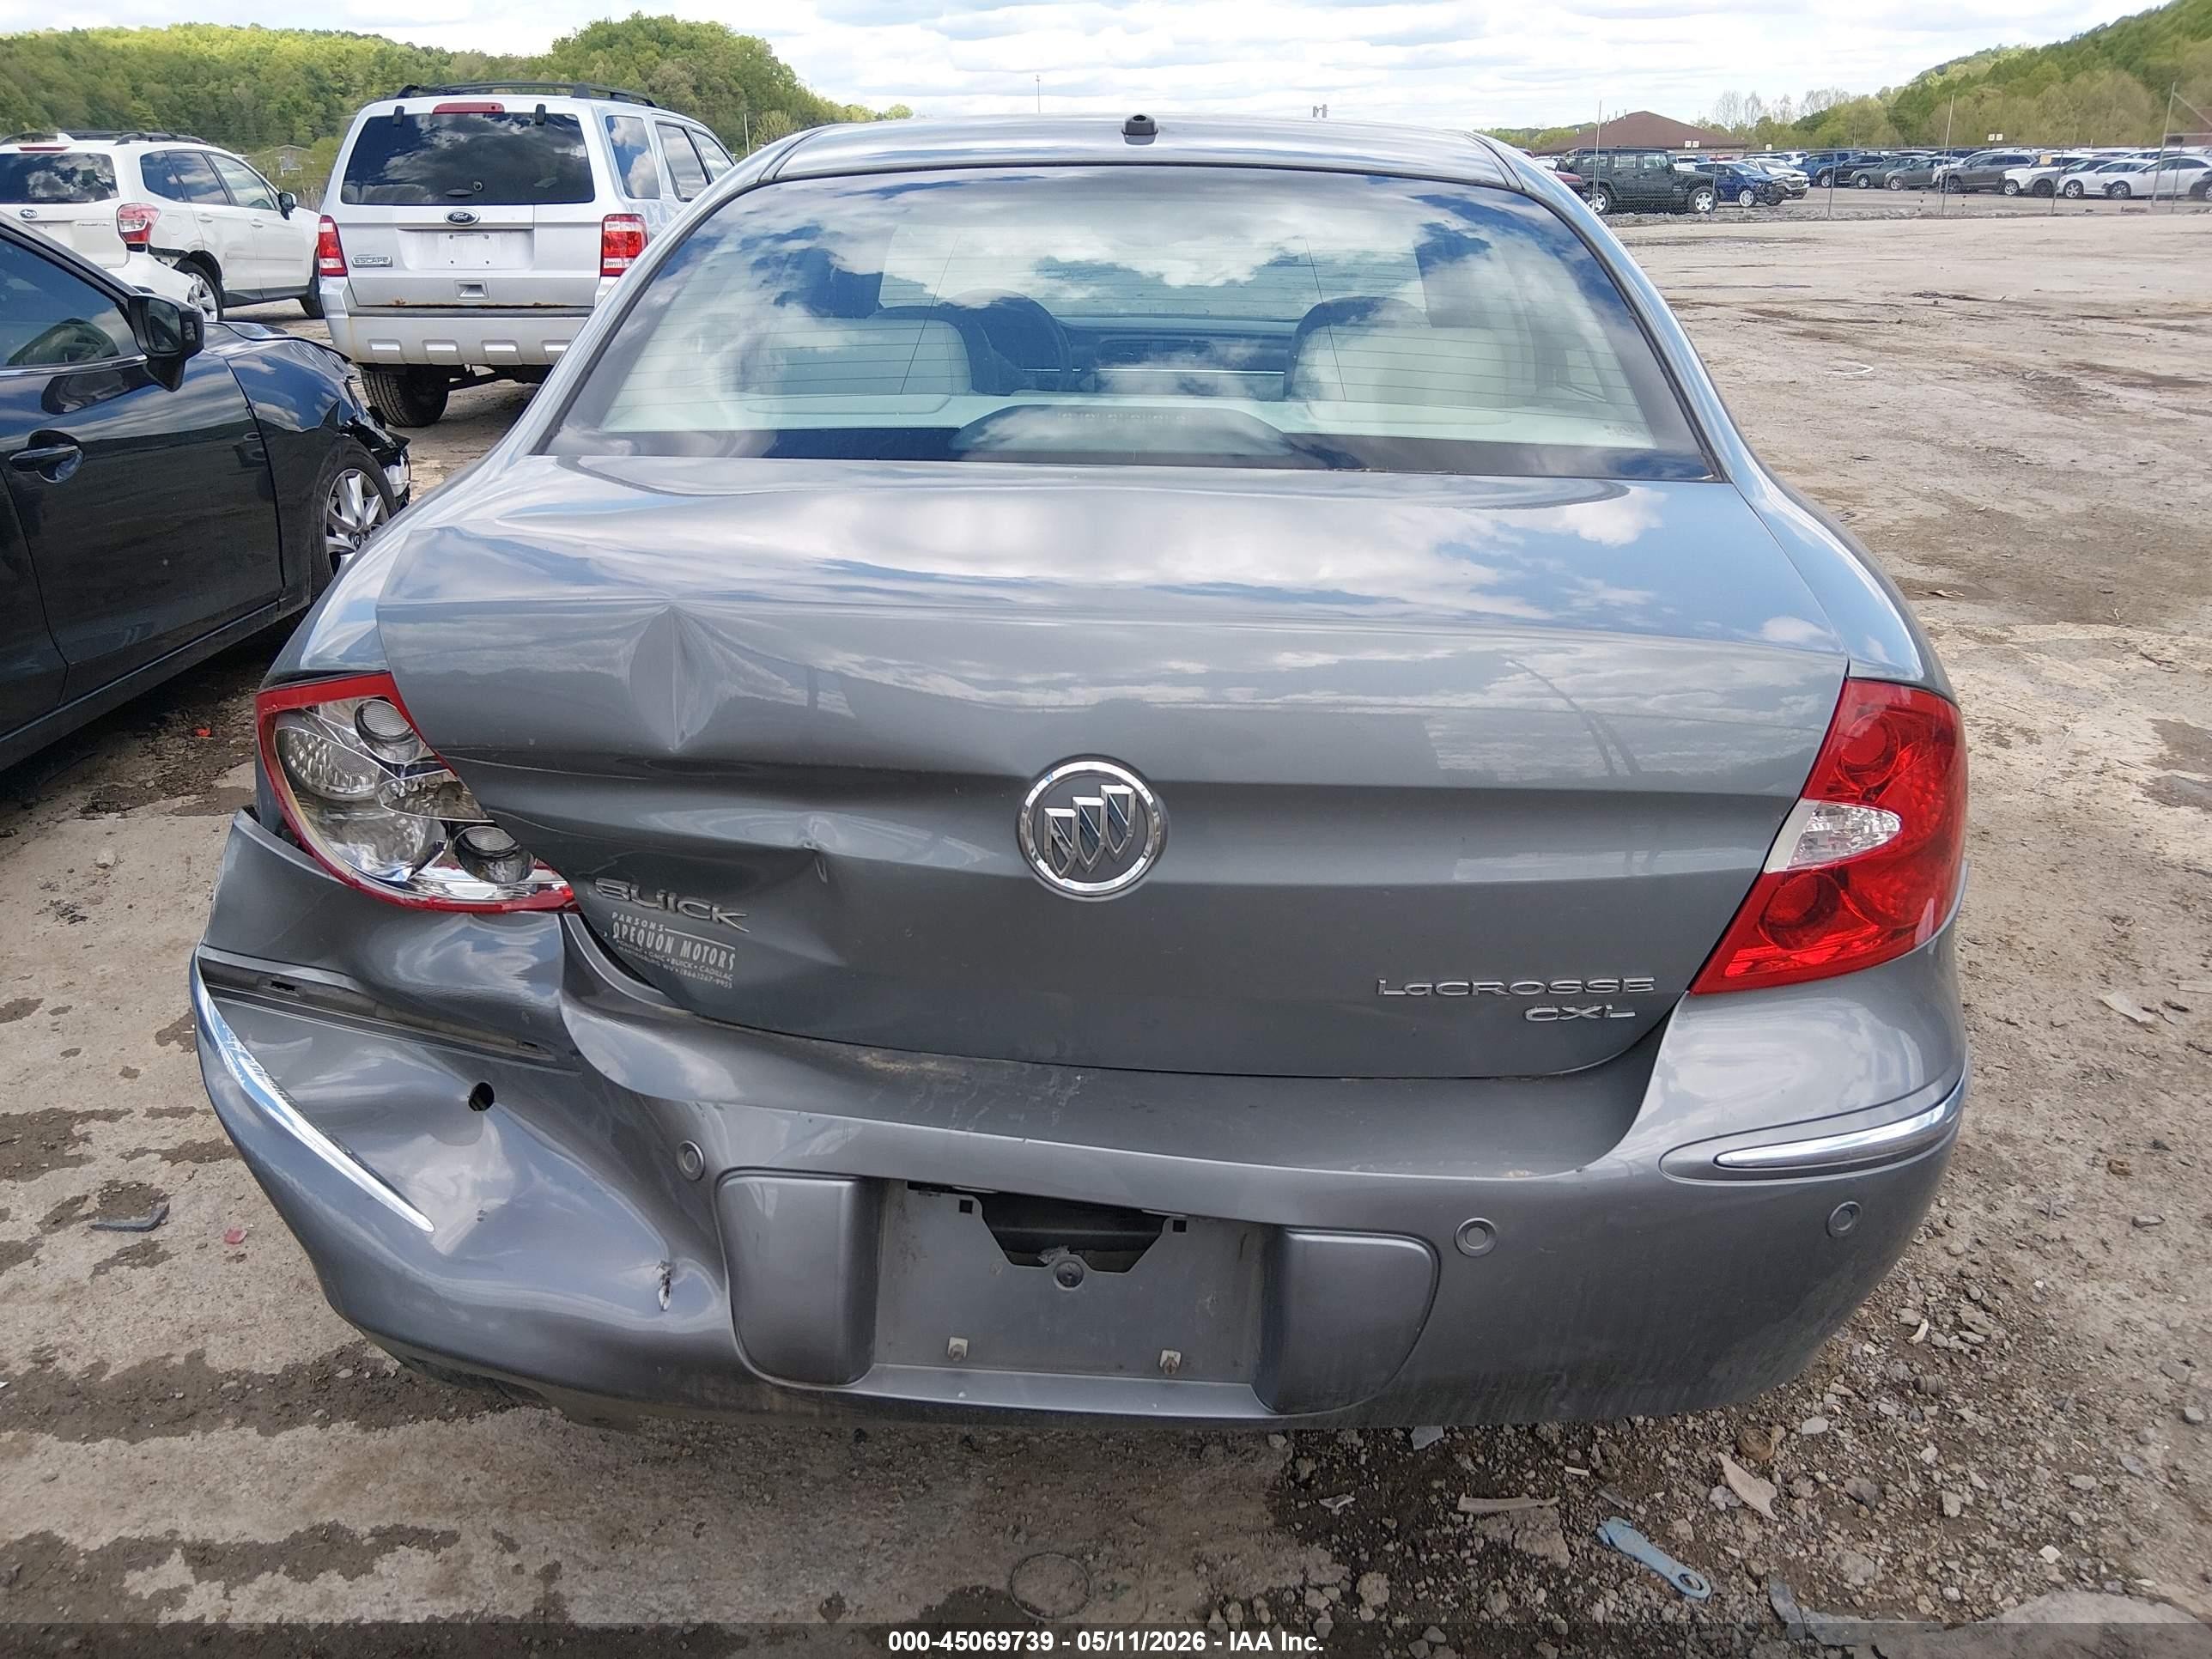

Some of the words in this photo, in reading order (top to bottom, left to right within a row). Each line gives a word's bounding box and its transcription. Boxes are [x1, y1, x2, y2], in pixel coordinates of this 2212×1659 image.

[595, 878, 750, 933] BUICK
[611, 911, 665, 932] PARSONS
[612, 921, 675, 954] OPEQUON
[679, 940, 736, 971] MOTORS
[670, 957, 693, 969] BUICK
[699, 965, 733, 981] CADILLAC
[1523, 1003, 1637, 1022] CXL
